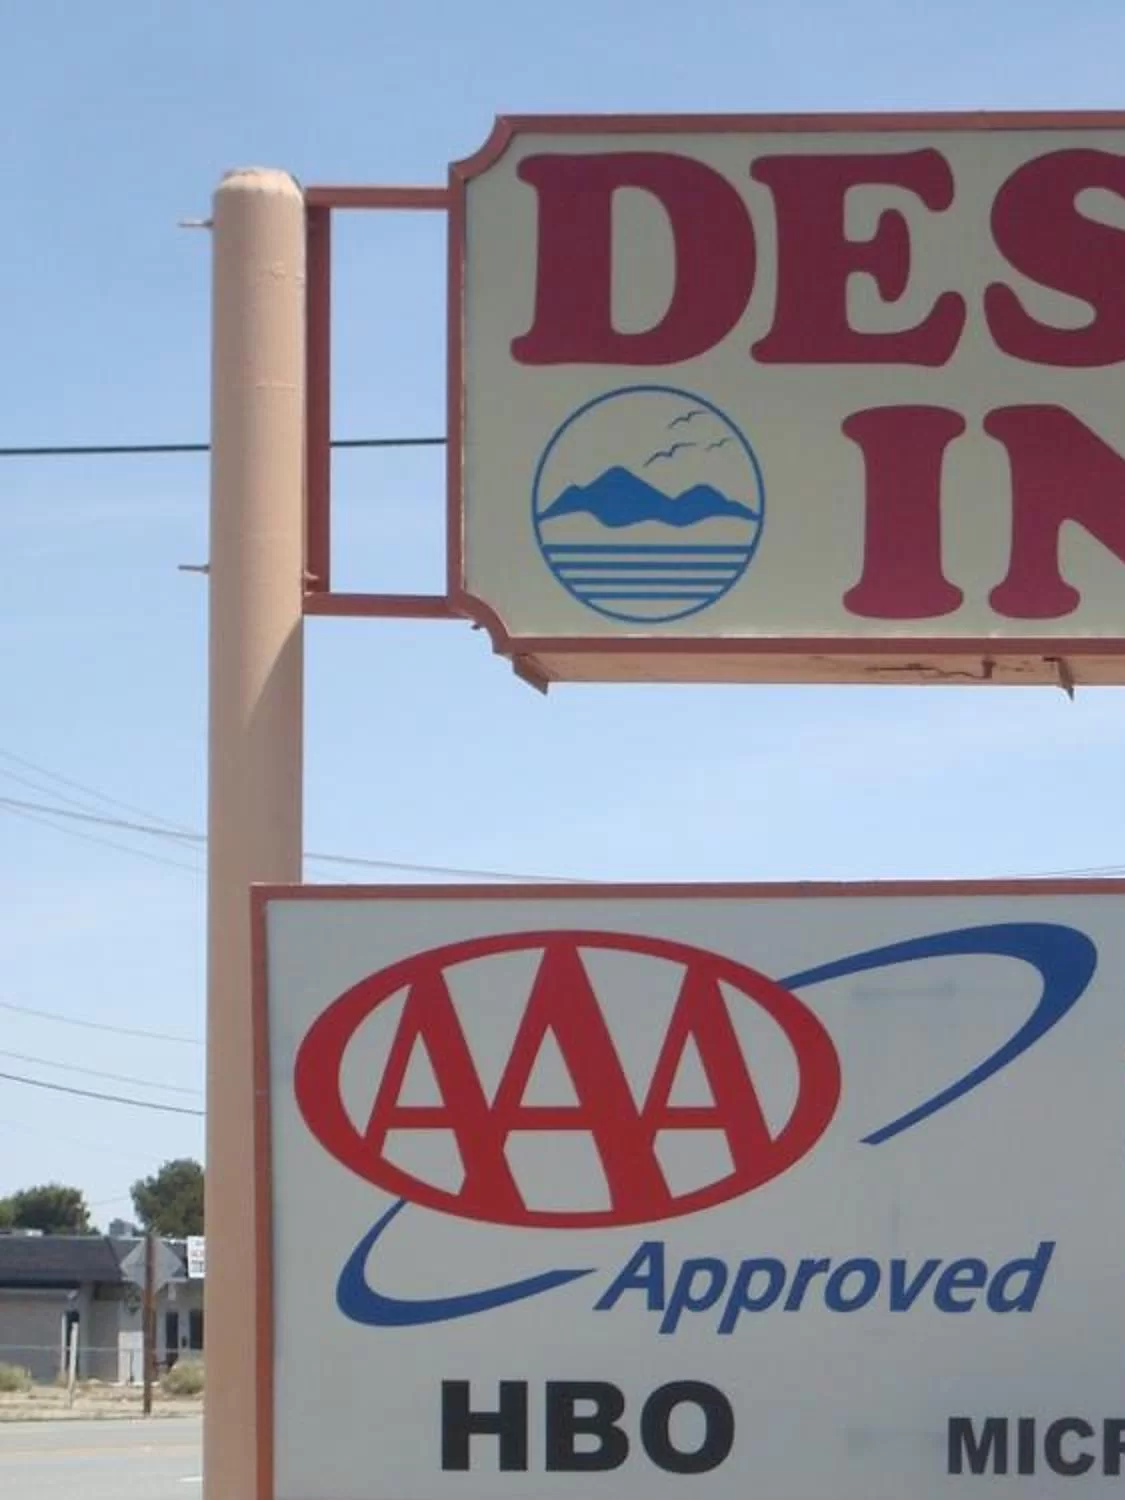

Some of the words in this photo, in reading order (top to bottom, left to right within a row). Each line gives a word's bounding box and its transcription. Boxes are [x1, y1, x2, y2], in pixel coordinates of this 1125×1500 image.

[325, 930, 815, 1230] AAA
[592, 1241, 1055, 1335] Approved
[440, 1379, 736, 1475] HBO
